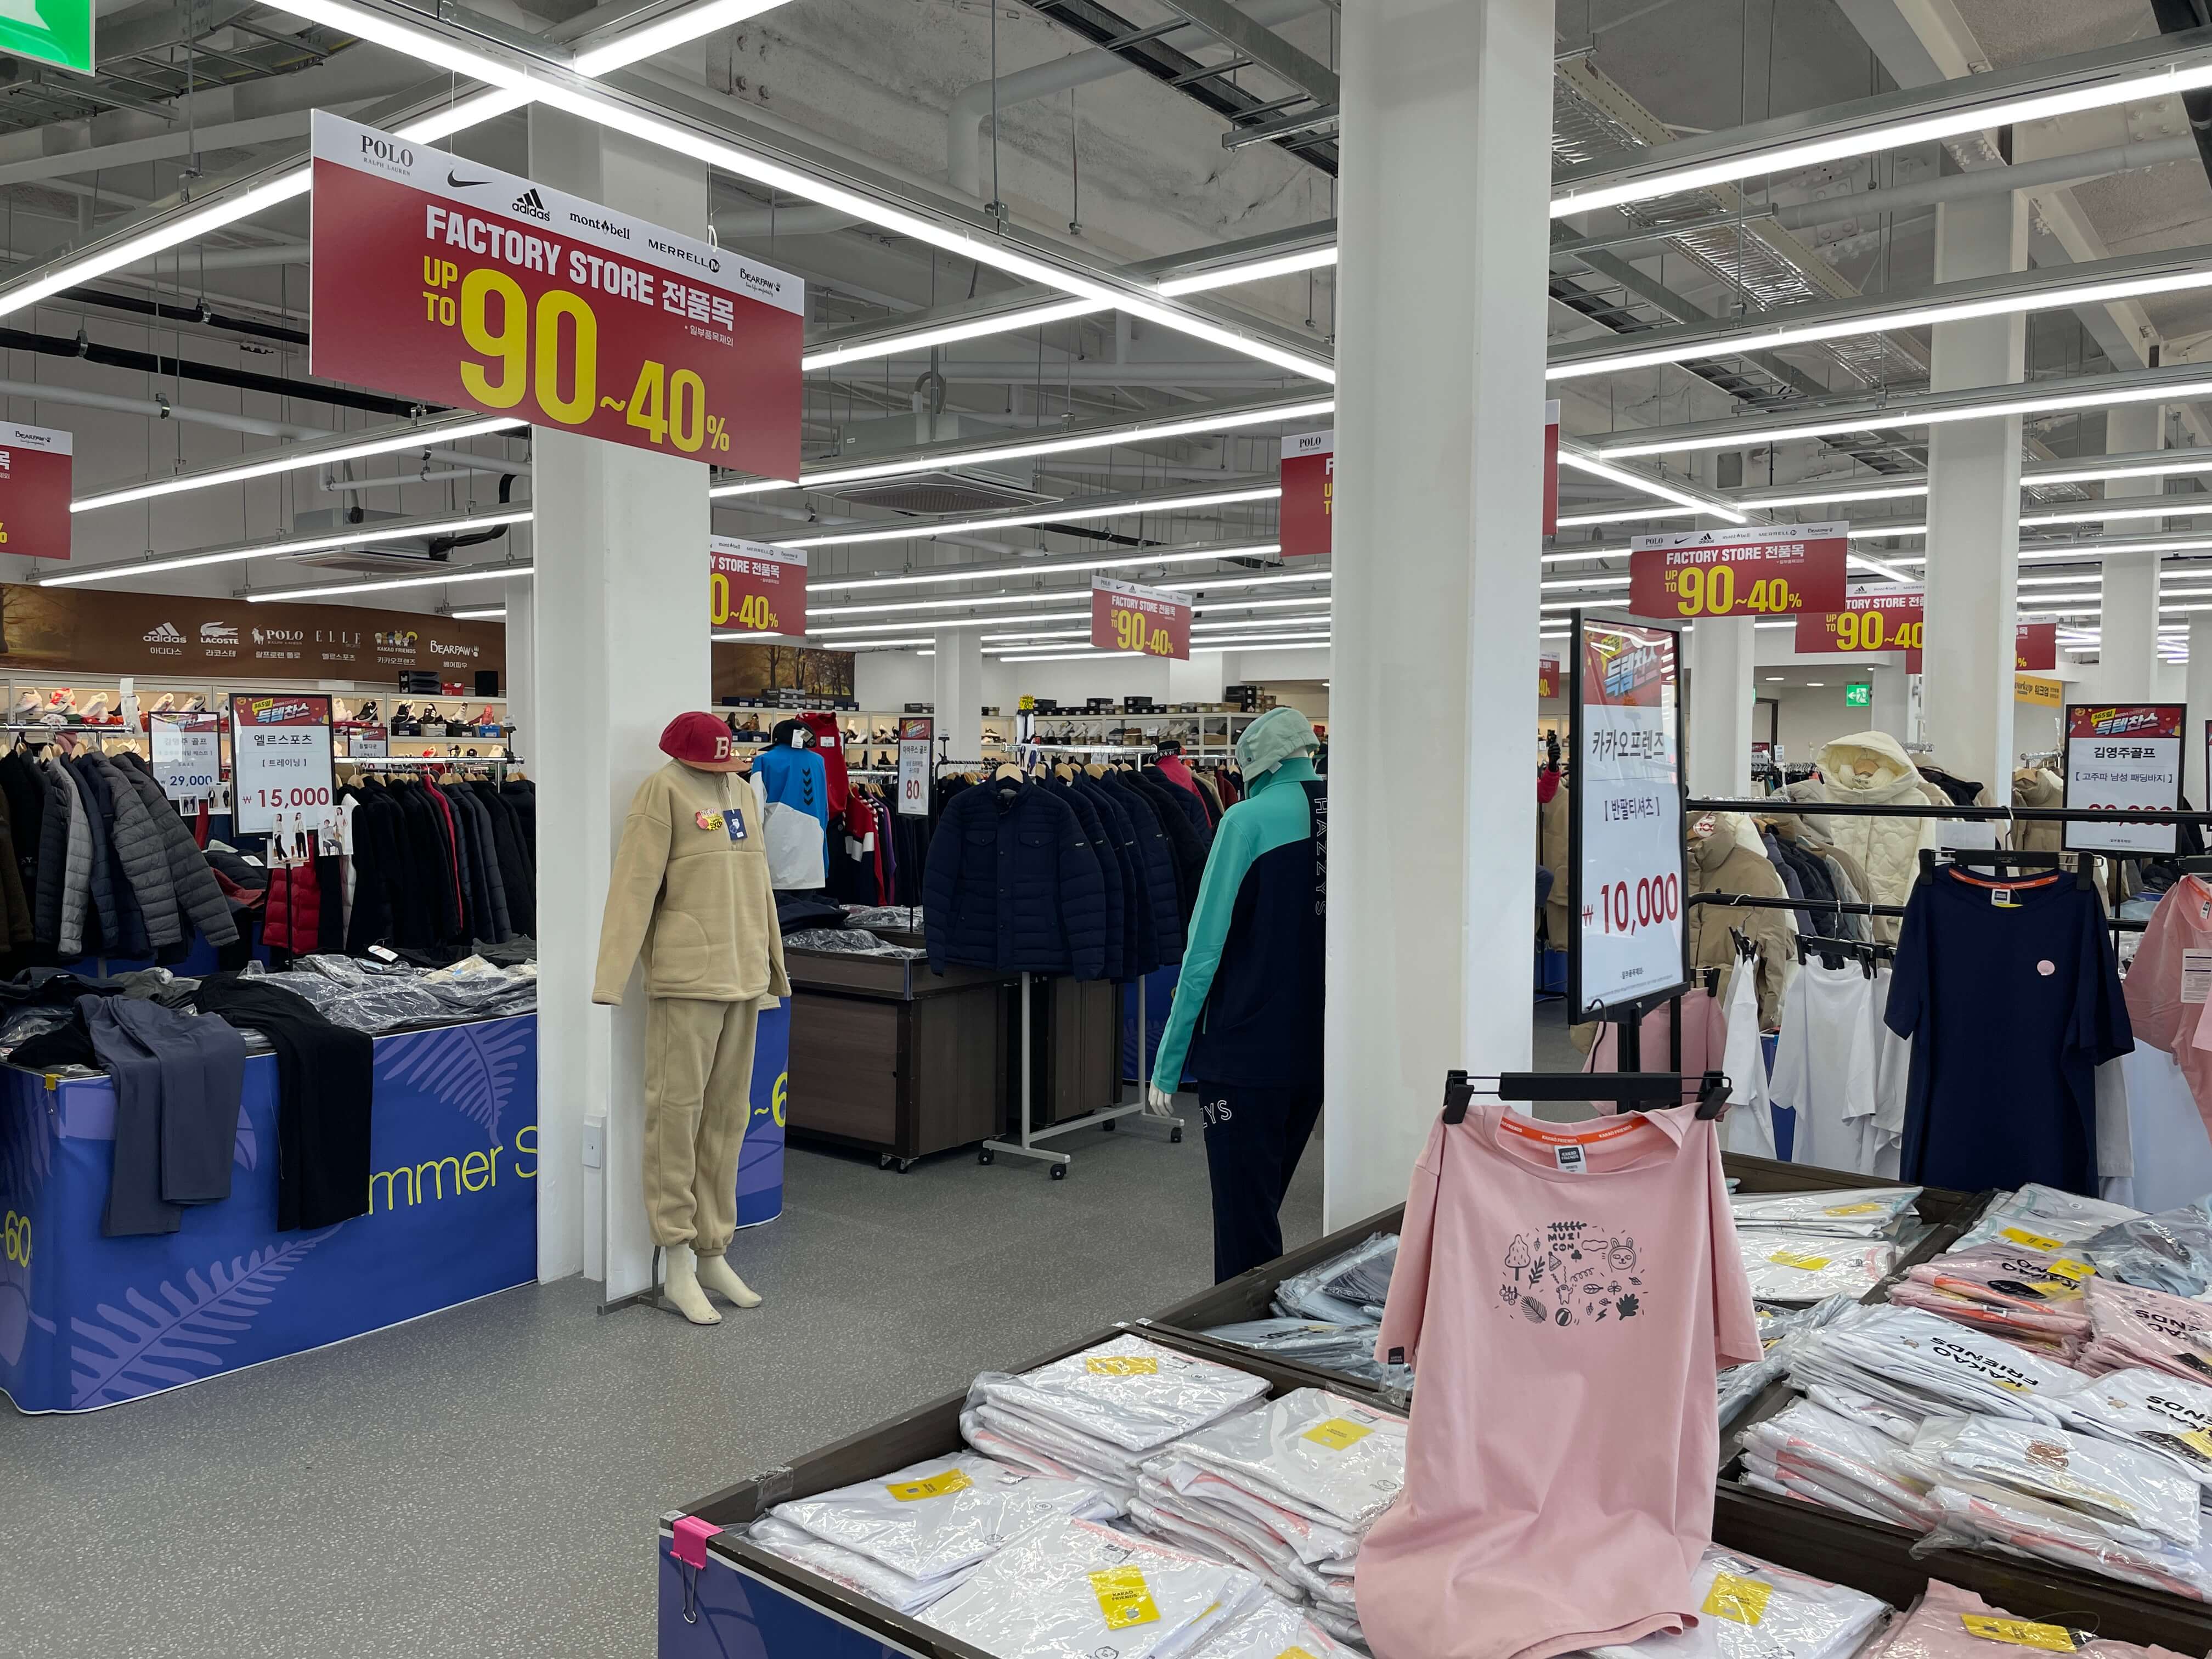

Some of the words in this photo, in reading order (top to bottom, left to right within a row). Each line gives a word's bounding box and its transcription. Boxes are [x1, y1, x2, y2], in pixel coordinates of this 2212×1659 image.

[361, 135, 413, 167] POLO
[364, 157, 384, 168] RALPH
[387, 165, 410, 176] LAUREN
[512, 200, 550, 222] adidas
[648, 239, 708, 268] MERRELL
[424, 256, 458, 288] UP
[426, 205, 562, 276] FACTORY
[569, 250, 654, 306] STORE
[662, 280, 734, 331] 전품목
[740, 267, 774, 289] BEARPAW
[423, 292, 456, 326] TO
[690, 325, 733, 347] 일부품목제외
[1299, 436, 1321, 448] POLO
[1666, 548, 1719, 565] FACTORY
[1722, 546, 1761, 561] STORE
[1765, 544, 1804, 559] 전품목
[719, 557, 749, 573] STORE
[752, 562, 780, 578] 전품목
[1665, 570, 1678, 580] UP
[1664, 582, 1677, 592] TO
[710, 573, 778, 630] 0~40%
[1111, 595, 1138, 609] FACTORY
[1139, 600, 1158, 613] STORE
[1847, 599, 1871, 610] TORY
[1873, 597, 1906, 608] STORE
[1110, 619, 1118, 628] TO
[1111, 610, 1118, 618] UP
[1826, 614, 1837, 623] UP
[266, 630, 303, 640] POLO
[316, 630, 360, 644] ELLE
[1826, 623, 1836, 633] TO
[1836, 611, 1923, 650] 90~40
[143, 635, 187, 644] adidas
[430, 640, 470, 656] BEARPAW
[150, 647, 182, 655] 아디다스
[322, 653, 356, 661] 엘르스포츠
[255, 702, 311, 723] 득템찬스
[2094, 711, 2113, 720] 365일
[2094, 713, 2159, 735] 득템찬스
[254, 734, 312, 746] 엘르스포츠
[714, 737, 730, 759] B
[1593, 729, 1664, 761] 카카오프렌즈
[2094, 747, 2155, 759] 김영주골프
[170, 776, 212, 787] 29,000
[2111, 773, 2128, 782] 남성
[258, 787, 329, 809] 15,000
[1601, 873, 1678, 935] 10,000
[369, 1146, 504, 1215] mmer
[515, 1126, 538, 1178] S
[1548, 1232, 1579, 1242] MUZI
[1553, 1243, 1574, 1251] CON
[1930, 1337, 2039, 1386] FRIENDS
[1933, 1346, 2023, 1387] KAKAO
[2146, 1396, 2212, 1425] ENDS
